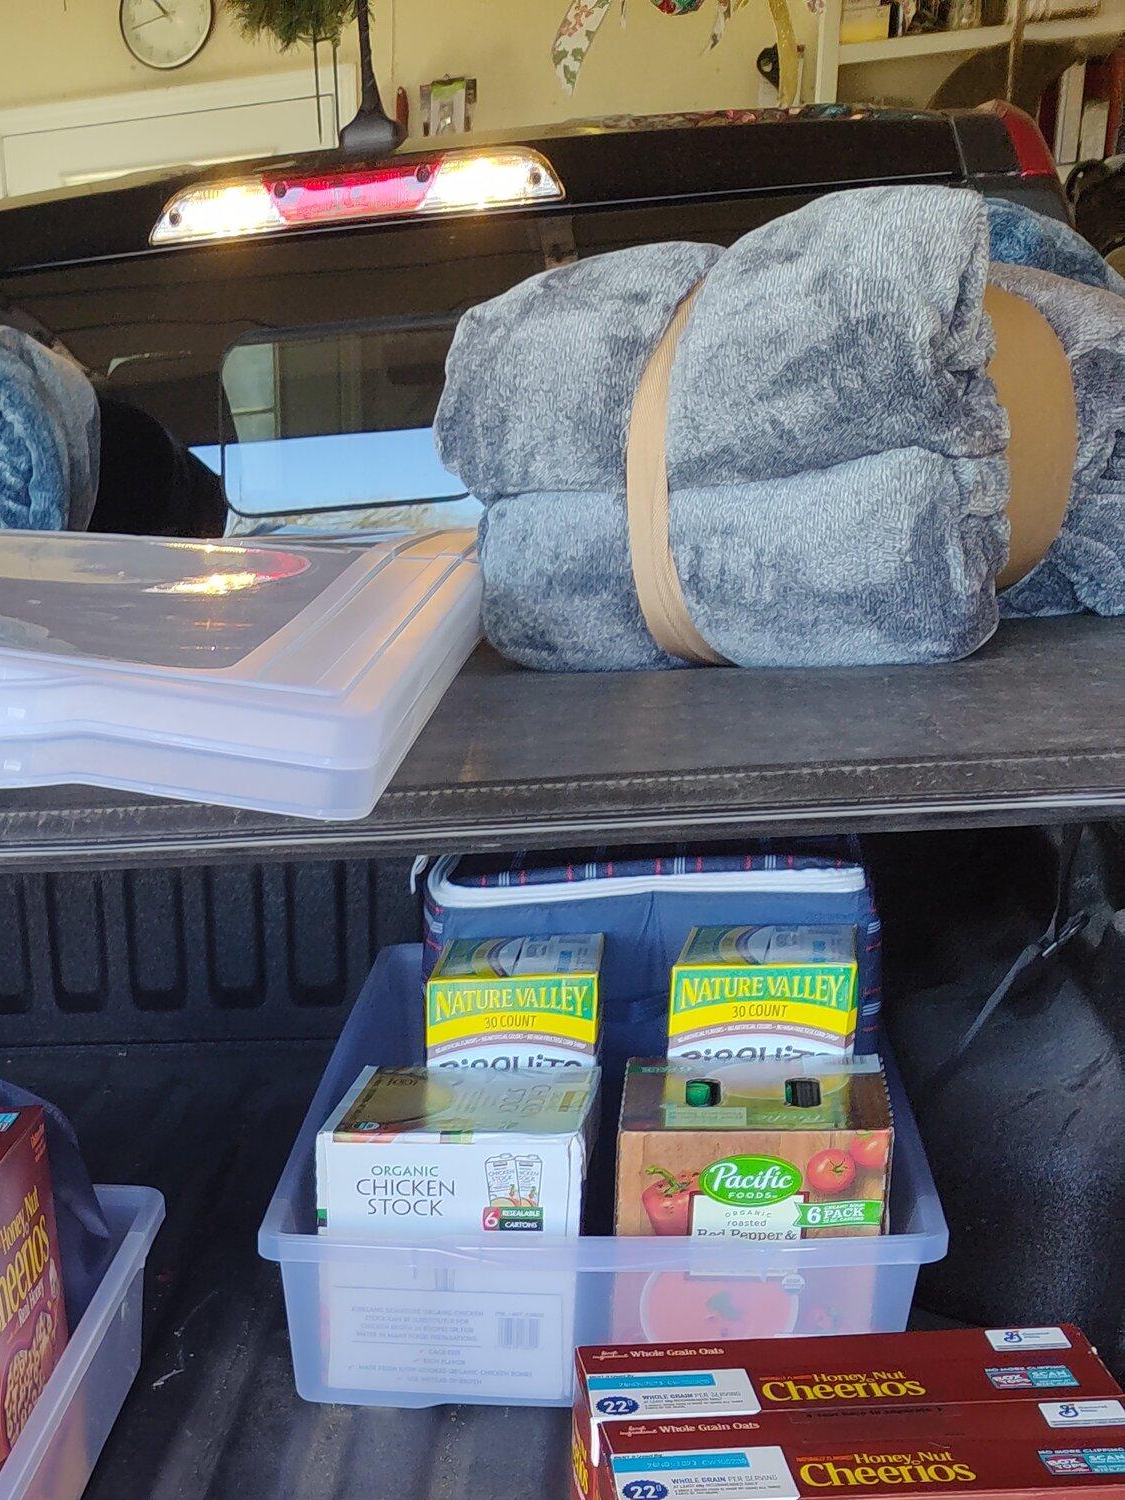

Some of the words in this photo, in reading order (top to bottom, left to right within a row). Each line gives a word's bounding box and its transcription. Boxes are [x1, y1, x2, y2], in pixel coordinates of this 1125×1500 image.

[680, 977, 764, 1010] NATURE
[768, 974, 846, 1007] VALLEY
[435, 988, 513, 1021] NATURE
[515, 985, 588, 1017] VALLEY
[732, 1005, 746, 1018] 30
[748, 1004, 788, 1018] COUNT
[484, 1017, 497, 1029] 30
[500, 1015, 537, 1029] COUNT
[371, 1165, 439, 1177] ORGANIC
[709, 1162, 794, 1192] Pacific
[356, 1178, 455, 1197] CHICKEN
[368, 1198, 444, 1217] STOCK
[725, 1209, 772, 1218] ORGANIC
[823, 1206, 865, 1219] PACK
[484, 1211, 498, 1228] 6
[806, 1206, 821, 1224] 6
[504, 1221, 538, 1229] CARTONS
[727, 1219, 767, 1227] roasted
[630, 1350, 664, 1358] Whole
[698, 1347, 725, 1355] Oats
[812, 1373, 868, 1383] Honey
[875, 1371, 907, 1380] Nut
[761, 1380, 926, 1401] Cheerios
[659, 1424, 696, 1433] Whole
[698, 1423, 731, 1432] Grain
[733, 1422, 760, 1430] Oats
[854, 1452, 912, 1465] Honey
[918, 1451, 954, 1463] Nut
[671, 1477, 700, 1485] WHOLE
[799, 1462, 977, 1488] Cheerios
